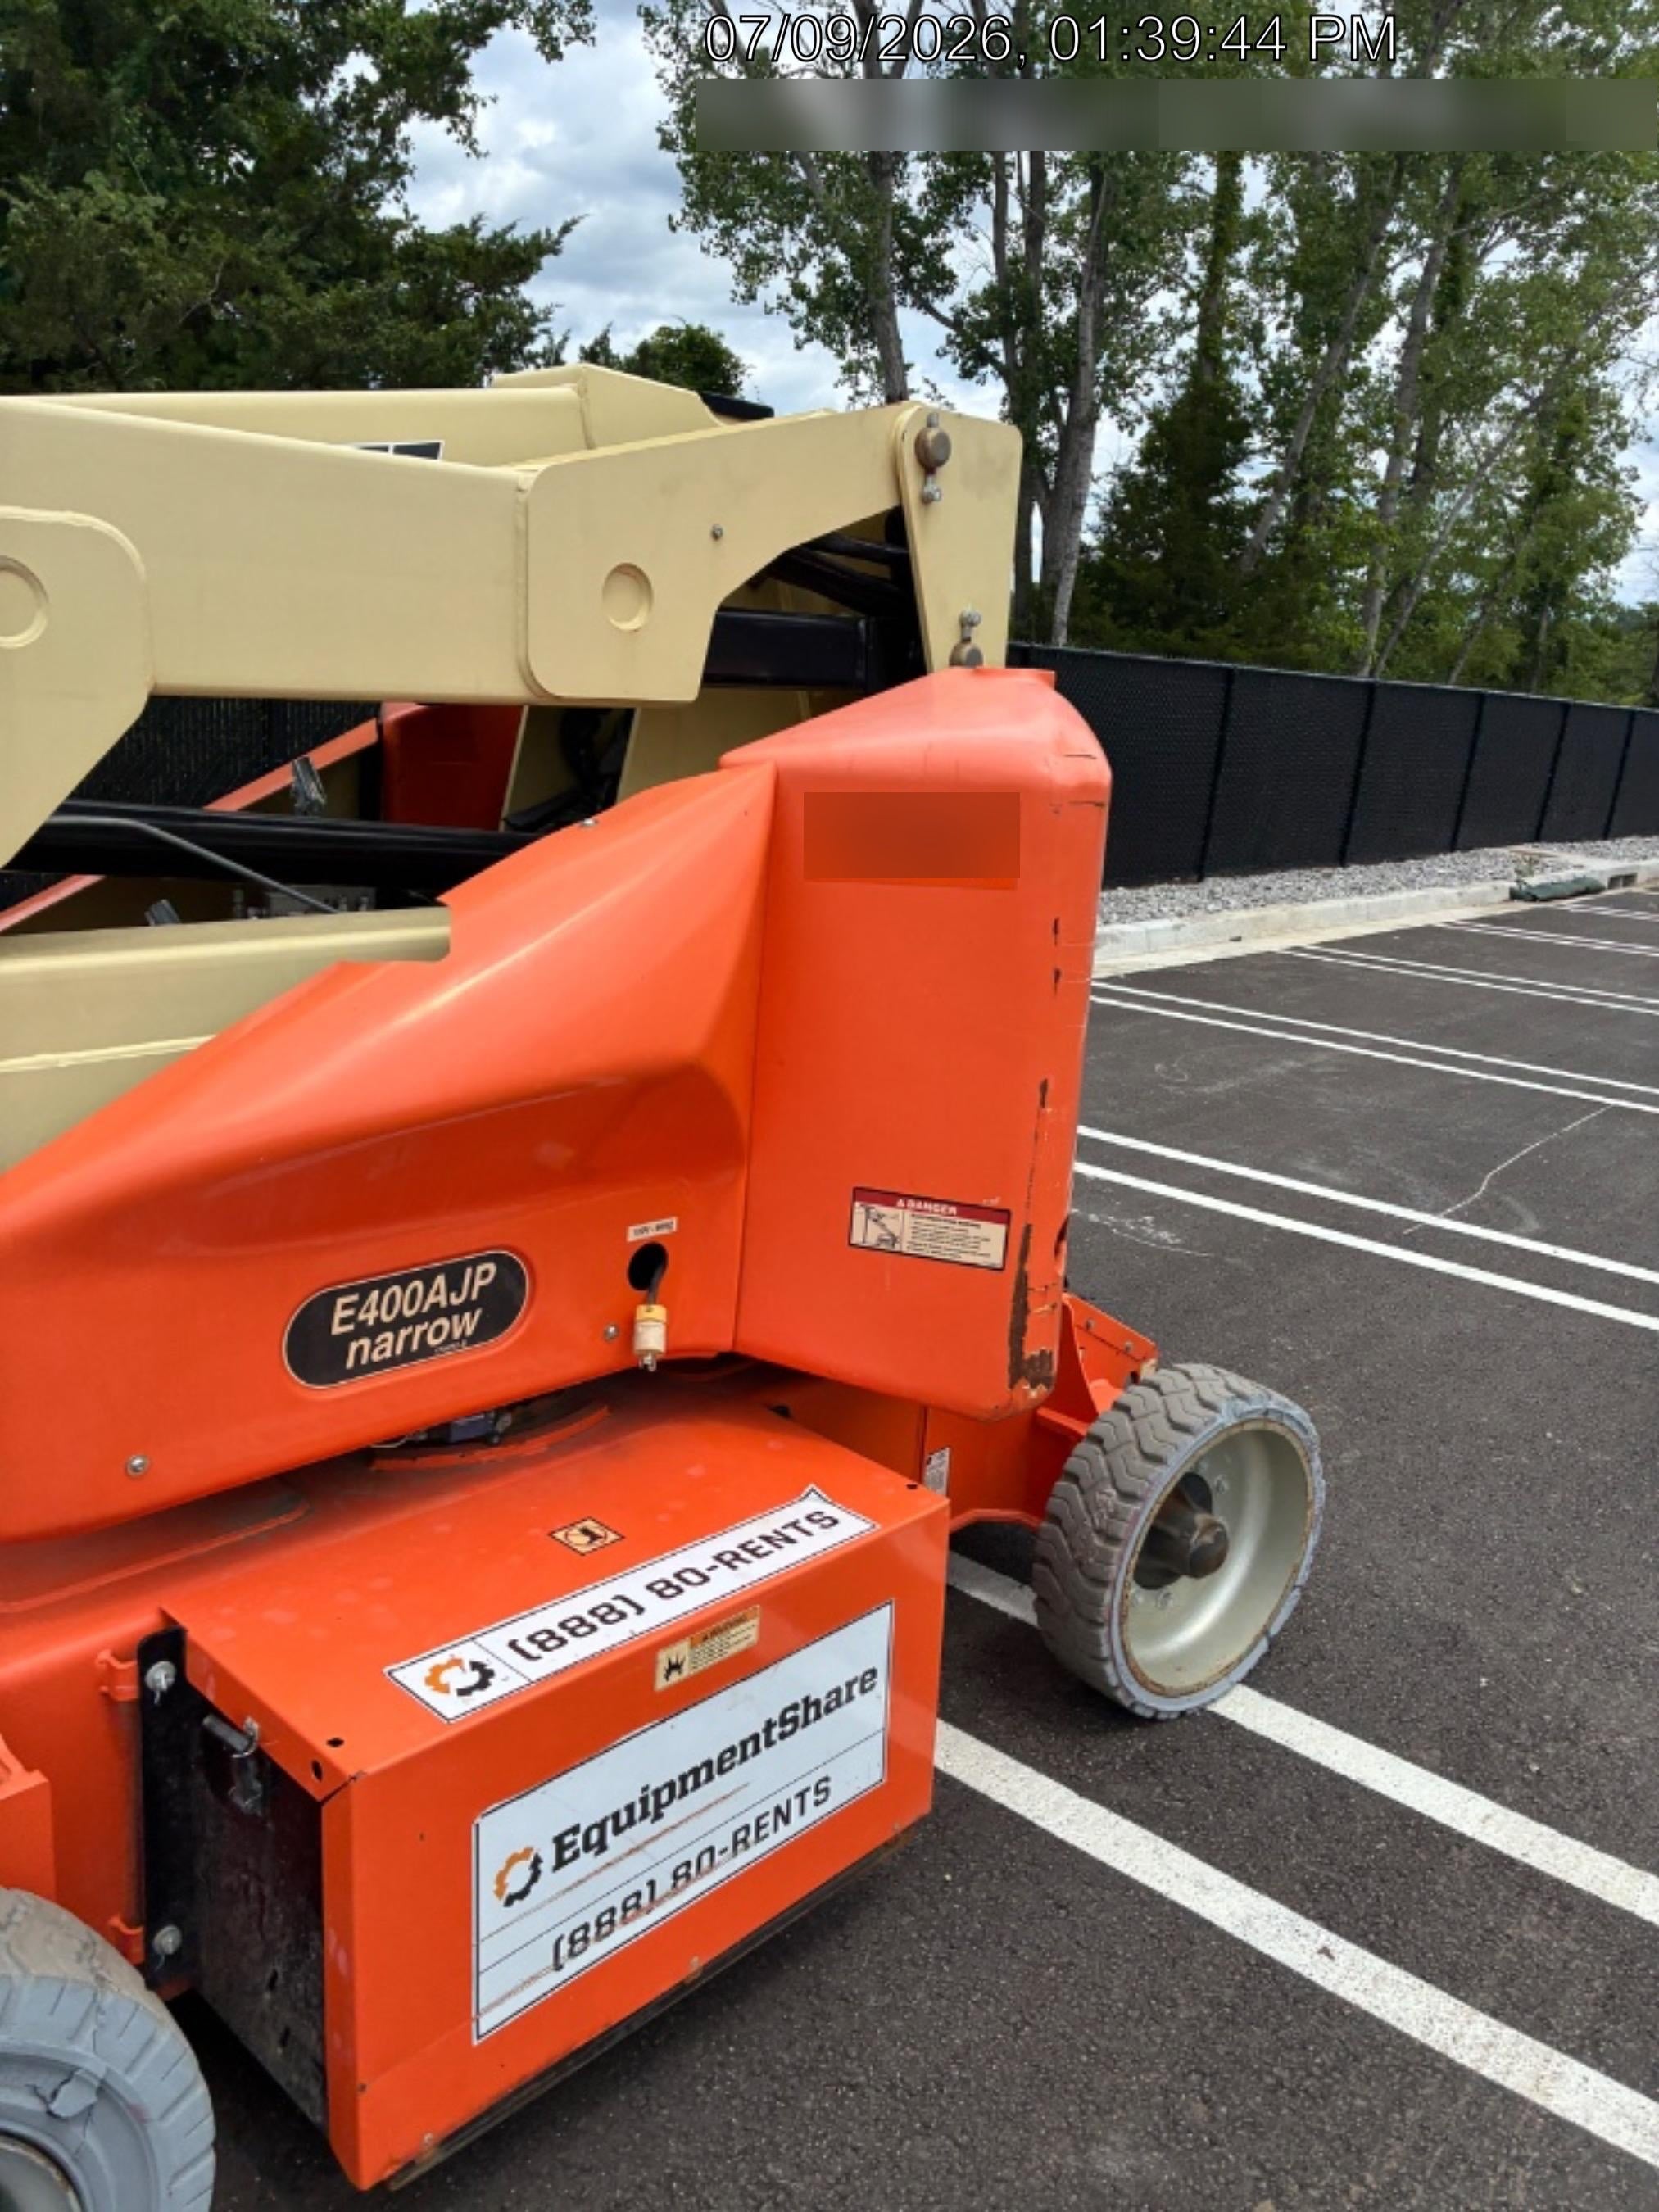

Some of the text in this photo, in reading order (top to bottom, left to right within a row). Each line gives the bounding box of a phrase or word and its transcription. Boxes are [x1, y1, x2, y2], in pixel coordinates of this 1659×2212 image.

[330, 1262, 498, 1336] E400AJP
[345, 1308, 482, 1370] narrow
[506, 1594, 645, 1663] (888)
[645, 1508, 841, 1601] 80-RENTS
[551, 1666, 879, 1873] EquipmentShare
[551, 1775, 832, 1970] (888) 80-RENTS
